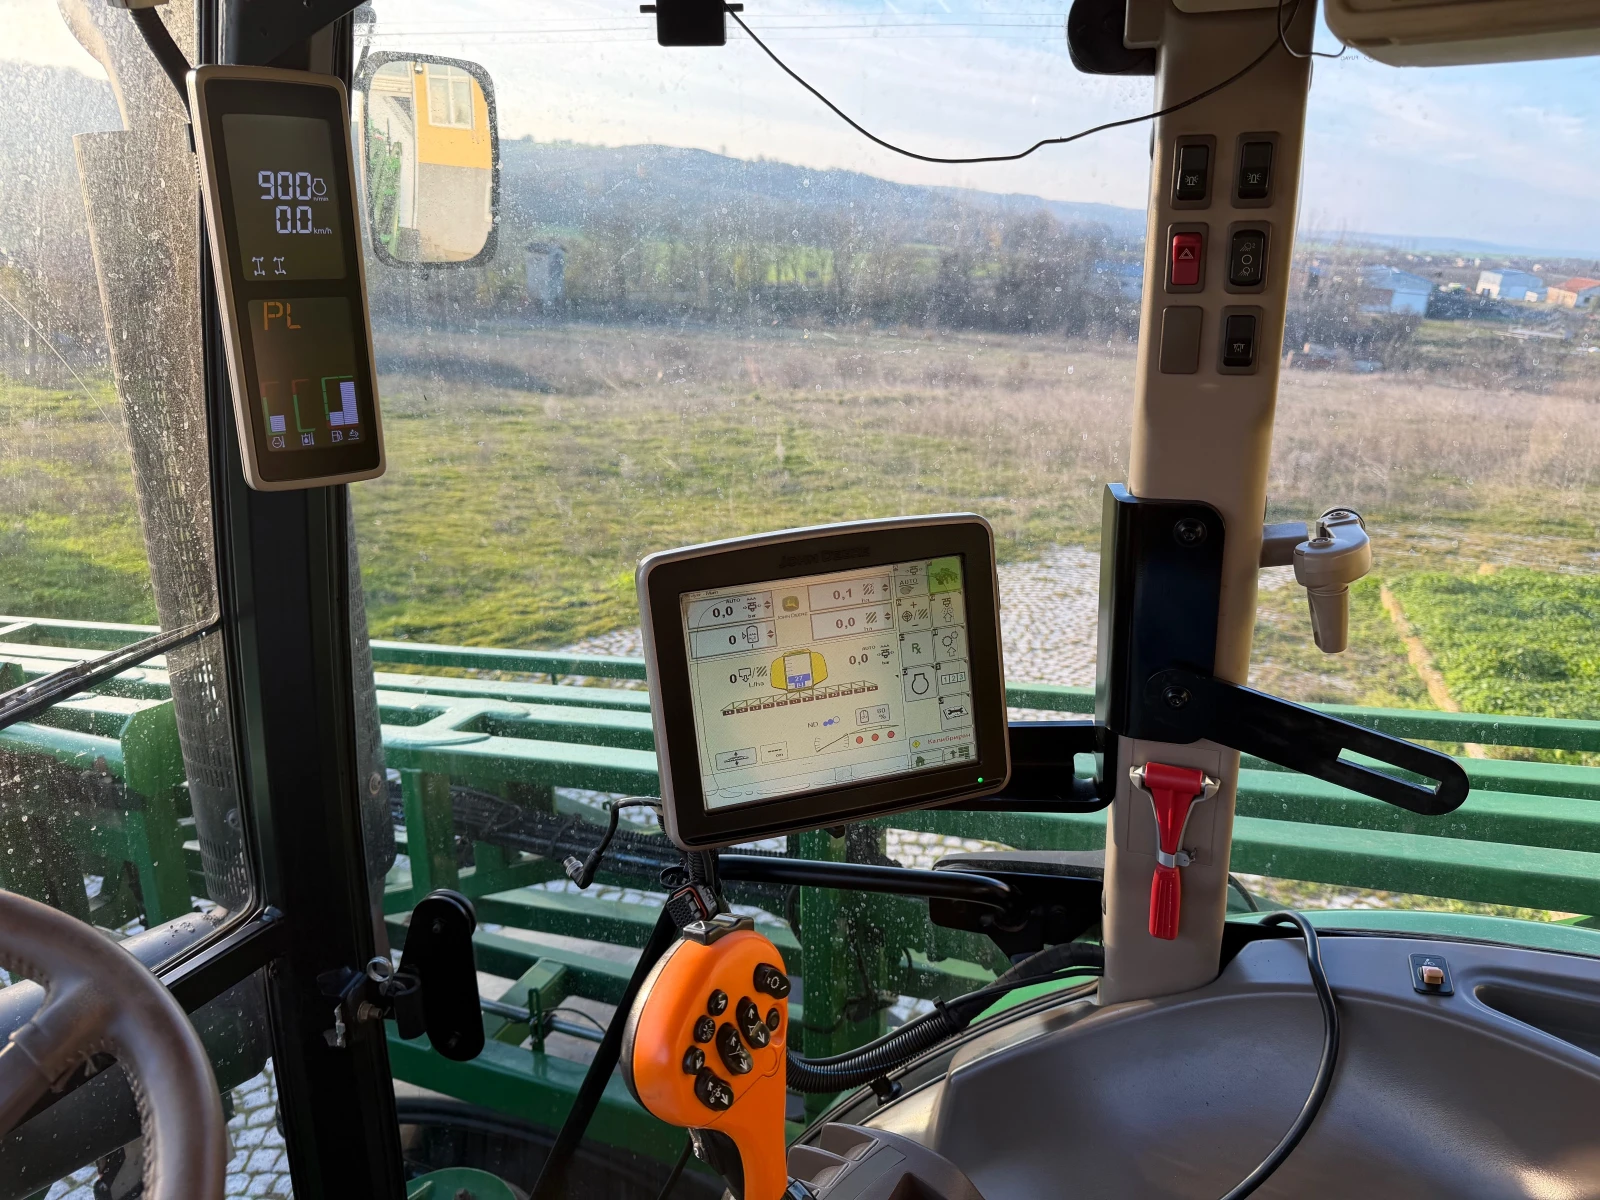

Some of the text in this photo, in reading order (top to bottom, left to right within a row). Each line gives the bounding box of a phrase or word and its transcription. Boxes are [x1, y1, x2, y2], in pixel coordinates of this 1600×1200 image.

[258, 170, 312, 201] 900
[275, 205, 332, 235] 0.0 km/h
[263, 301, 302, 331] PL
[899, 578, 918, 586] AUTO
[832, 588, 852, 601] 0,1
[712, 605, 733, 618] 0,0
[835, 617, 856, 629] 0,0
[728, 634, 737, 645] 0
[848, 653, 869, 666] 0,0
[729, 673, 737, 684] 0
